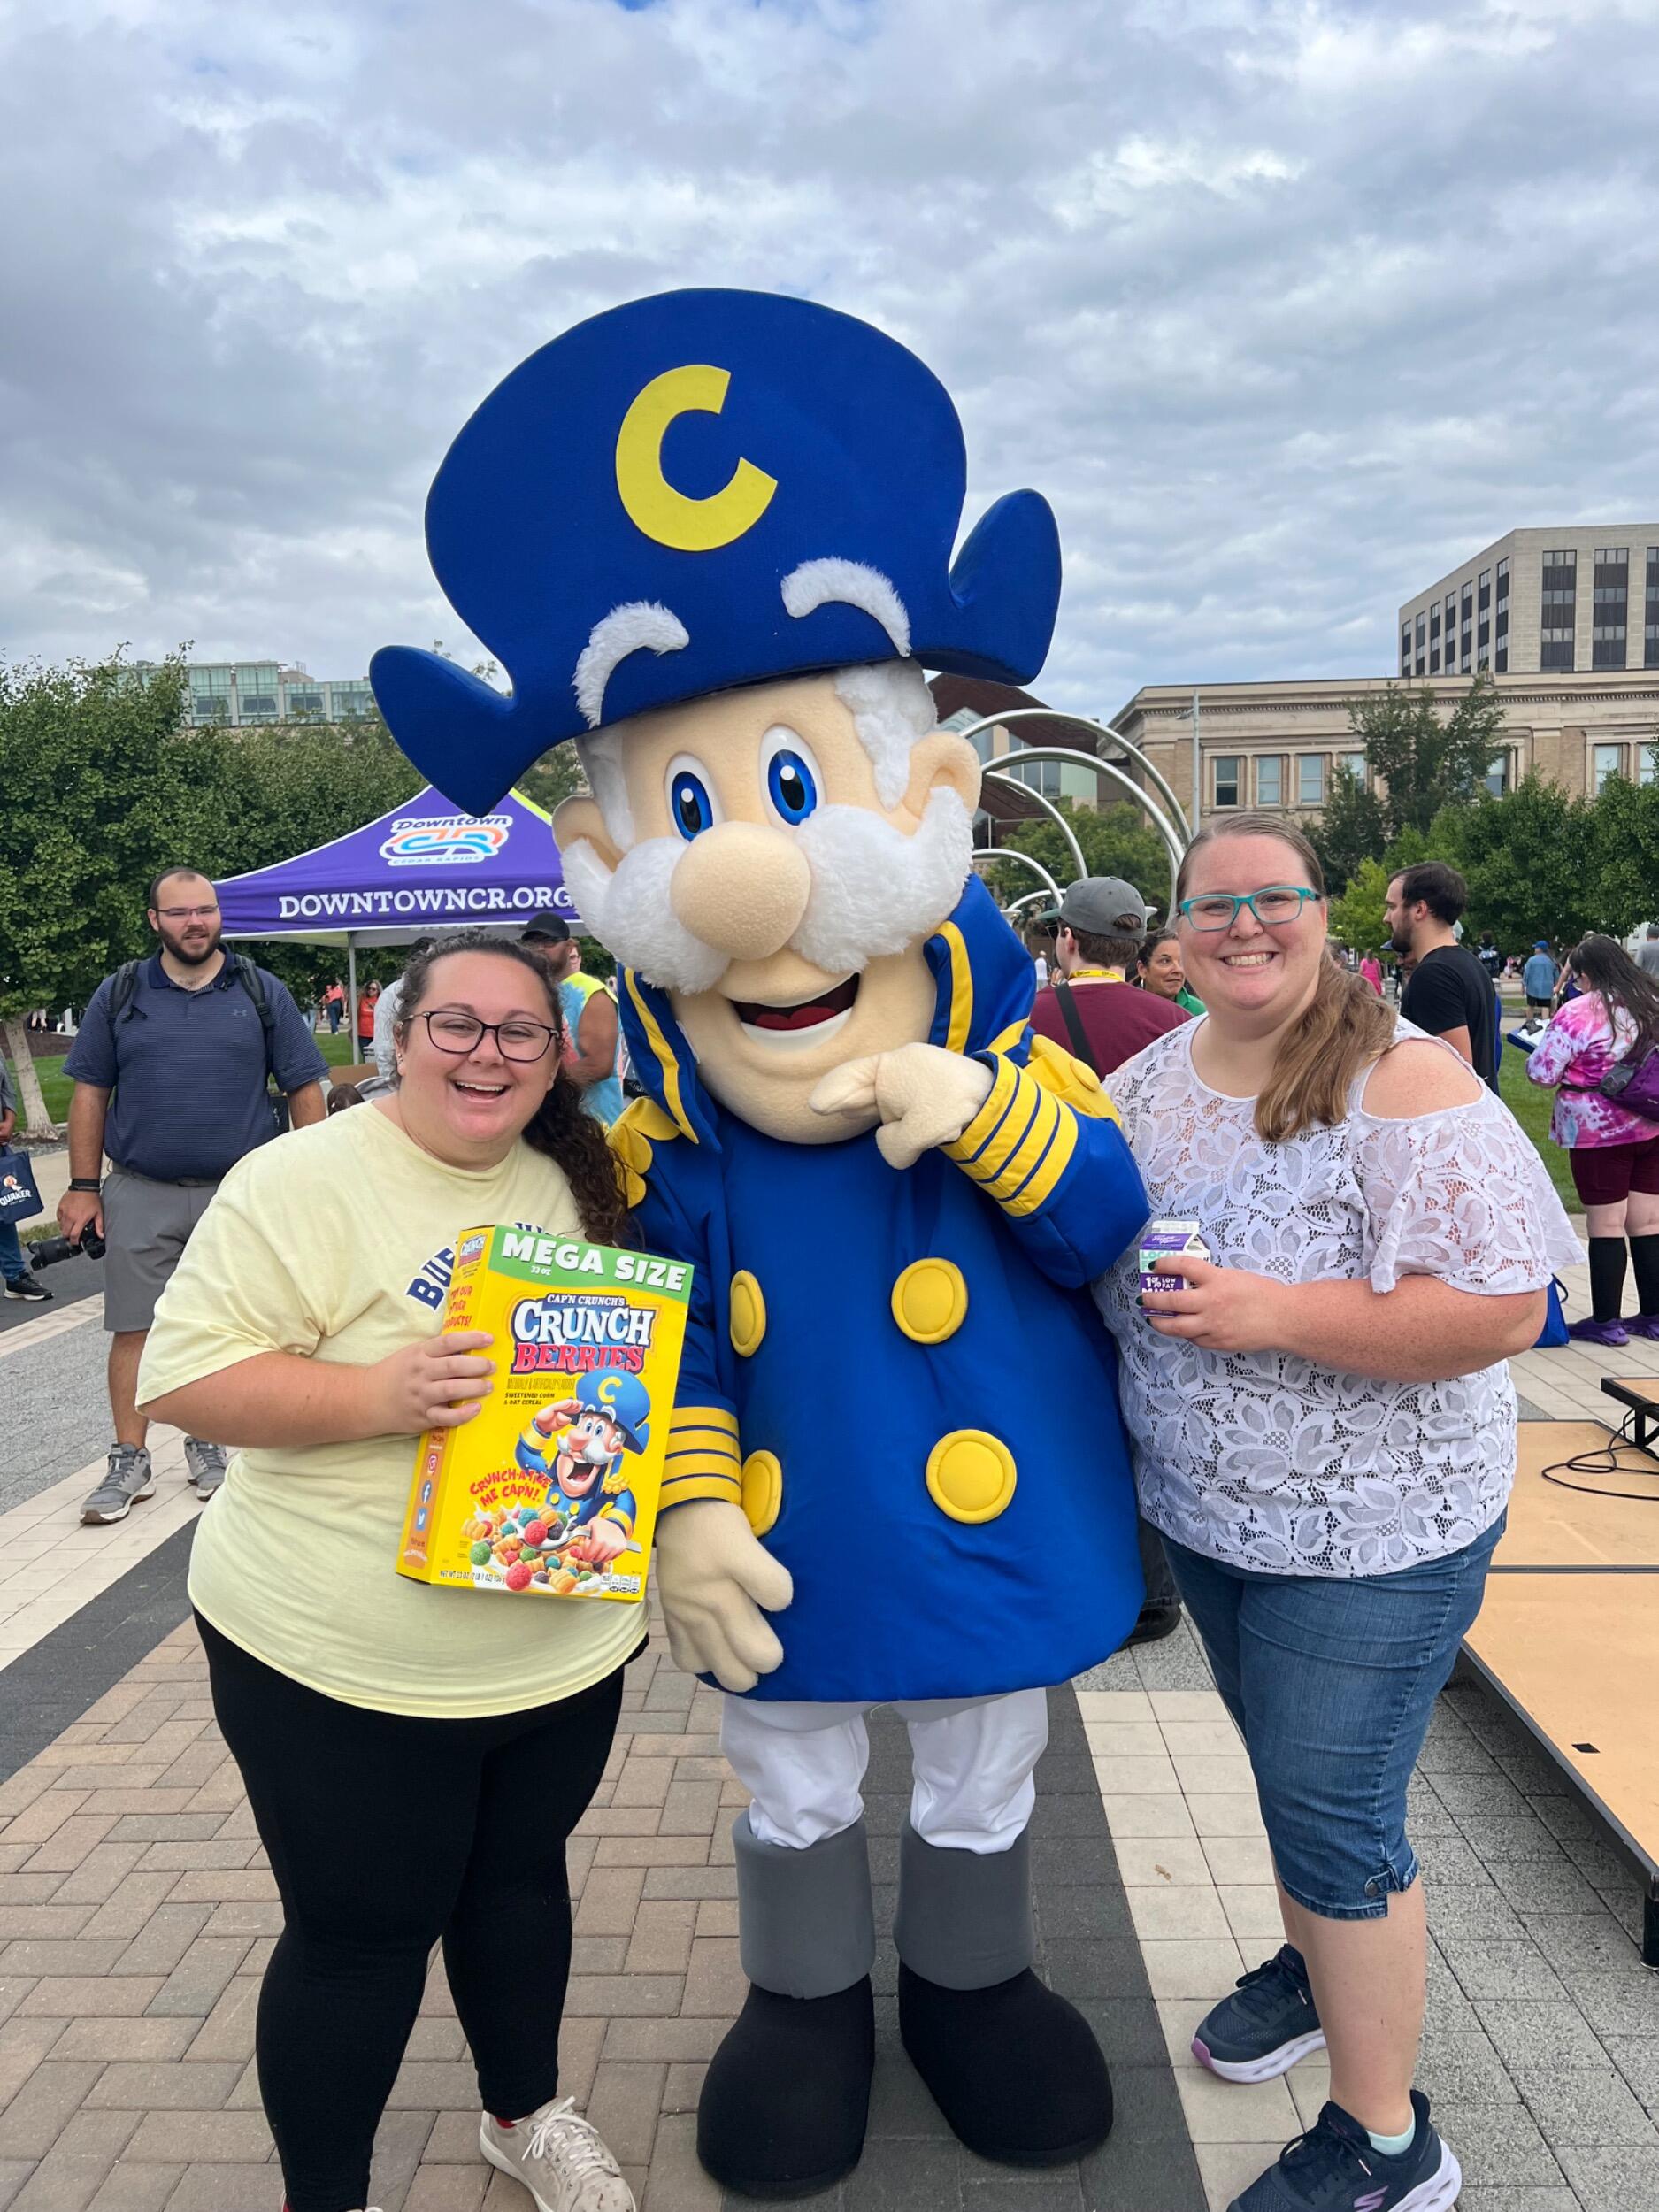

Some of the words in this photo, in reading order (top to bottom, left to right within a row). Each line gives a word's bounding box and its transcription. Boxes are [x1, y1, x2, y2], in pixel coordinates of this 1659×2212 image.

[616, 364, 779, 552] C
[397, 818, 507, 830] Downtown
[279, 887, 572, 918] DOWNTOWNCR.ORG
[0, 1189, 32, 1206] QUAKER
[502, 1232, 603, 1275] MEGA
[614, 1255, 687, 1291] SIZE
[1146, 1277, 1161, 1288] 1%
[547, 1294, 576, 1305] CAP'N
[578, 1295, 625, 1306] CRUNCH'S
[514, 1300, 654, 1347] CRUNCH
[513, 1342, 643, 1372] BERRIES
[597, 1376, 623, 1404] C
[480, 1488, 499, 1507] ME
